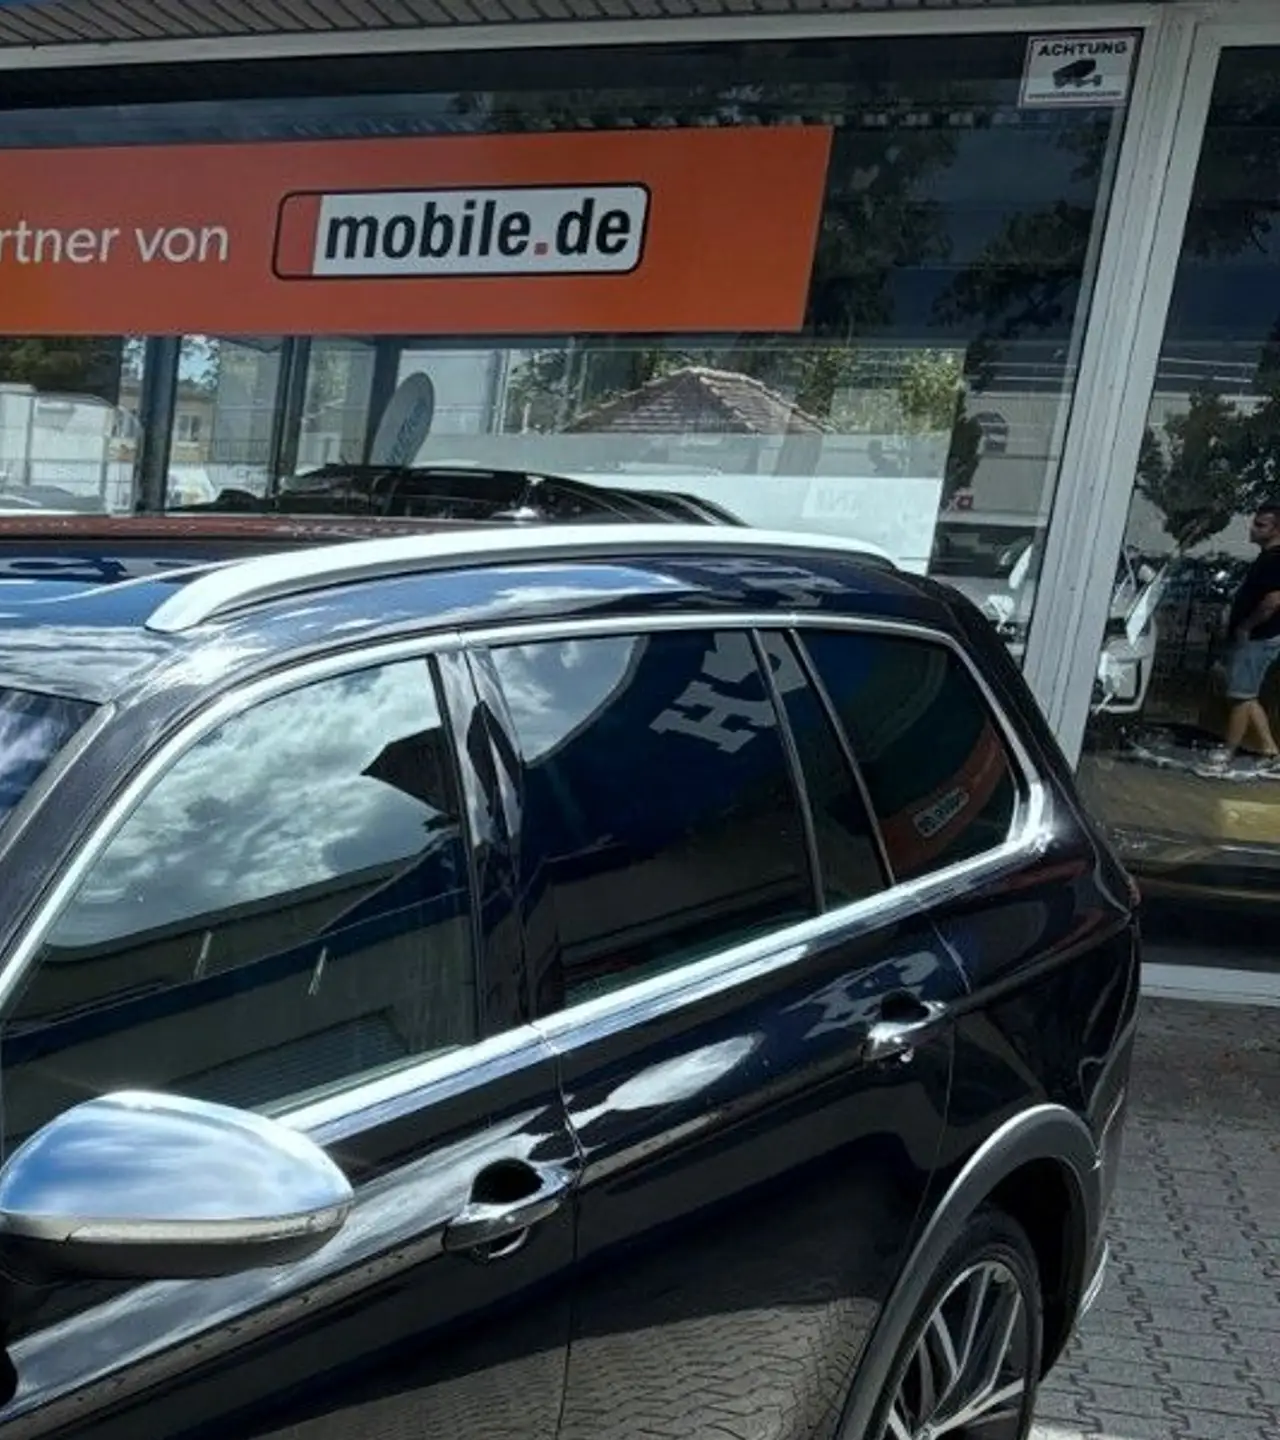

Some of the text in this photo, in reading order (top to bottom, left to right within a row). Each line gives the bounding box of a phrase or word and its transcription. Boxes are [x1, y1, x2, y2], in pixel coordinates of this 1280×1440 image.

[1038, 41, 1128, 56] ACHTUNG
[134, 225, 228, 263] von
[324, 198, 632, 260] mobile.de
